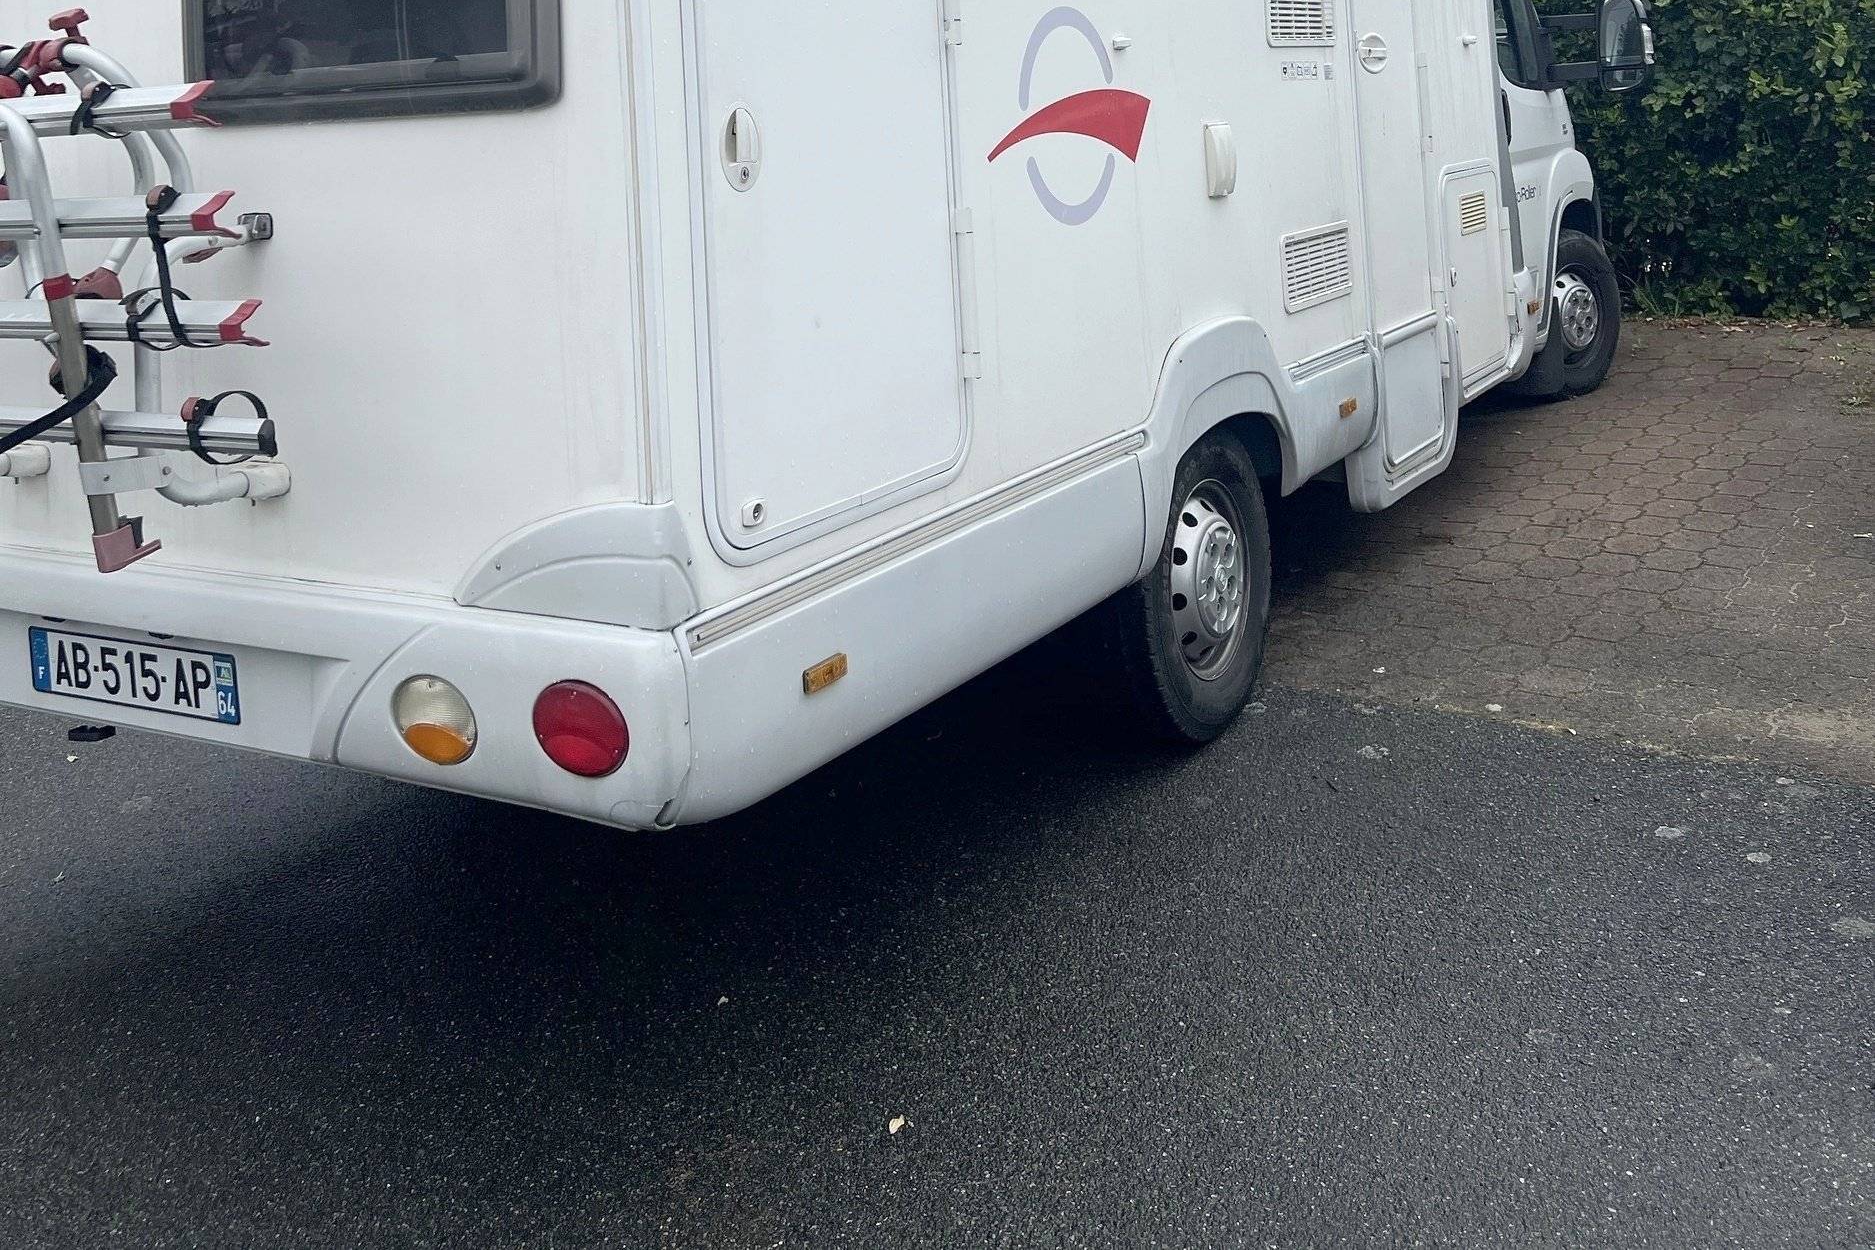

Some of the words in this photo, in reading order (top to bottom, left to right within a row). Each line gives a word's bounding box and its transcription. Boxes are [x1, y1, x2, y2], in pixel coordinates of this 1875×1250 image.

[38, 665, 46, 680] F
[56, 639, 212, 709] AB-515-AP
[217, 690, 236, 717] 64
